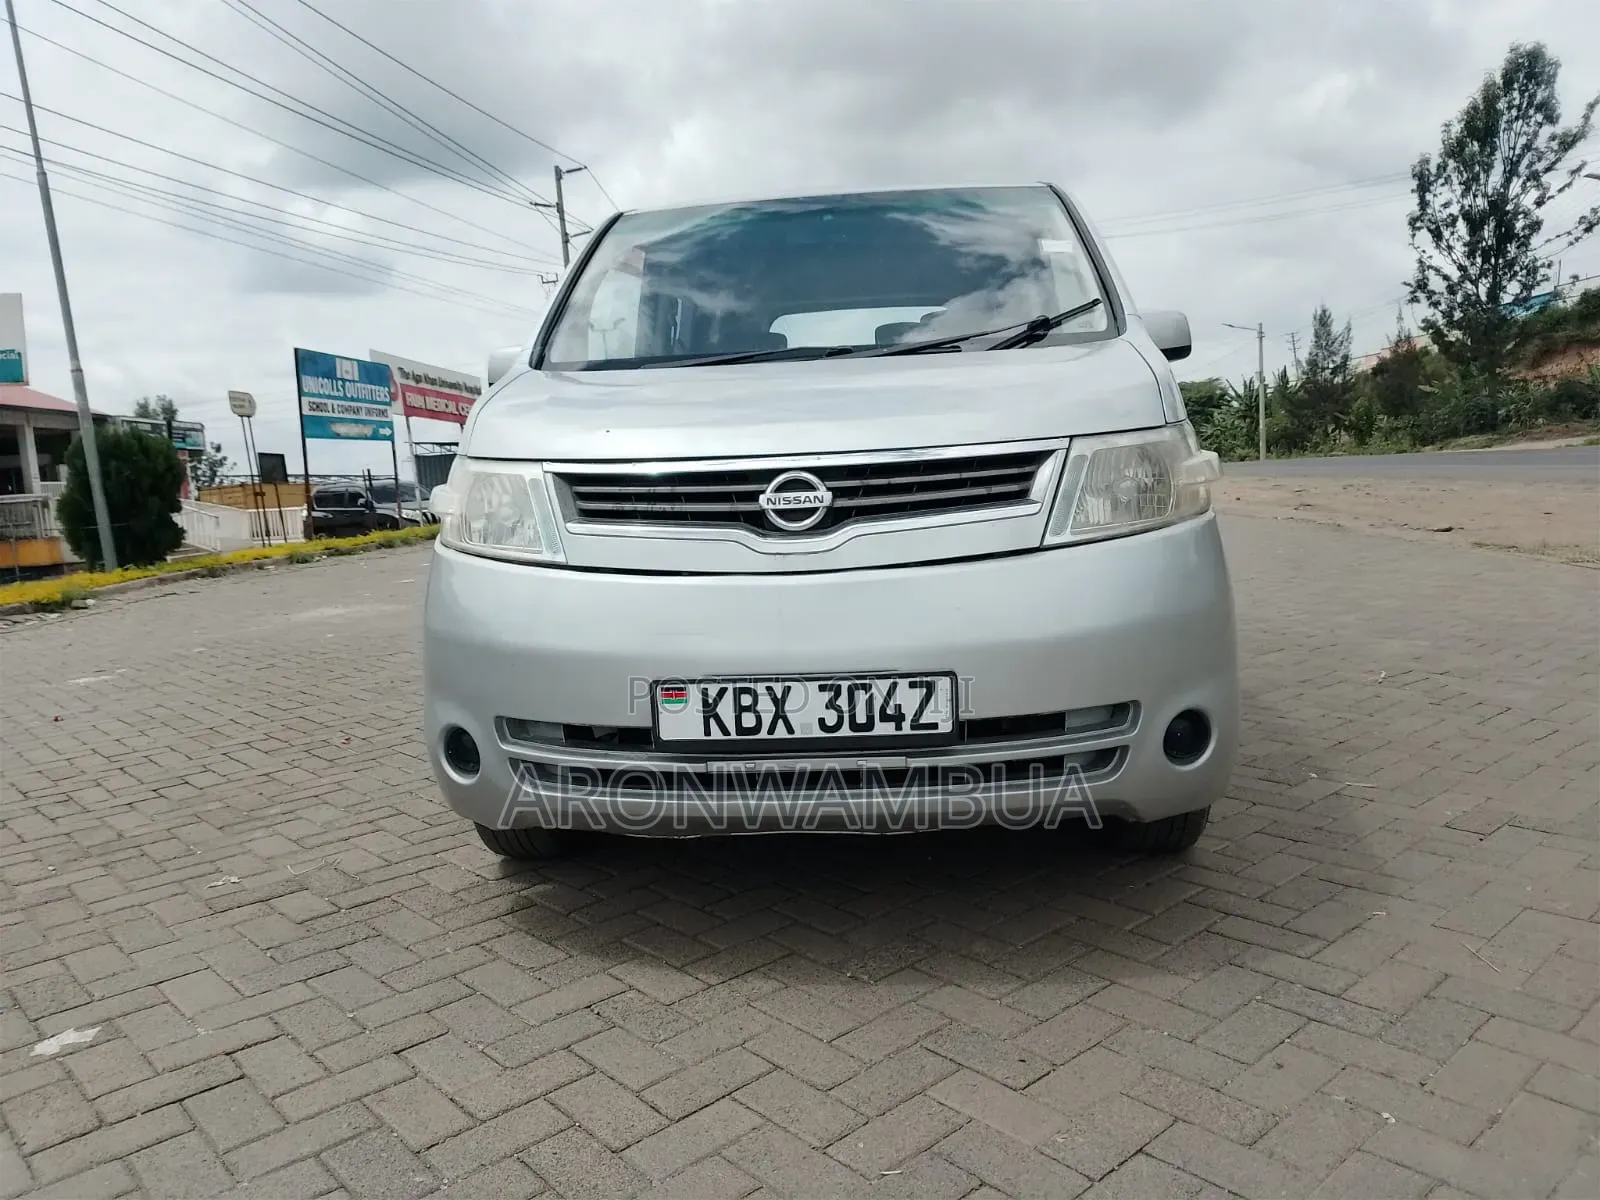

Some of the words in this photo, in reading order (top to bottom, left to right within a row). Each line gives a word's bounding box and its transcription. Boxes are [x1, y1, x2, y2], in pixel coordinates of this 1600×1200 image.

[302, 375, 344, 397] UNICOLLS
[345, 381, 390, 402] OUTFITTERS
[308, 401, 330, 413] SCHOOL
[337, 403, 363, 415] COMPANY
[364, 406, 389, 418] UNIFORMS
[767, 495, 824, 505] NISSAN
[701, 684, 796, 737] KBX
[817, 680, 940, 734] 304Z
